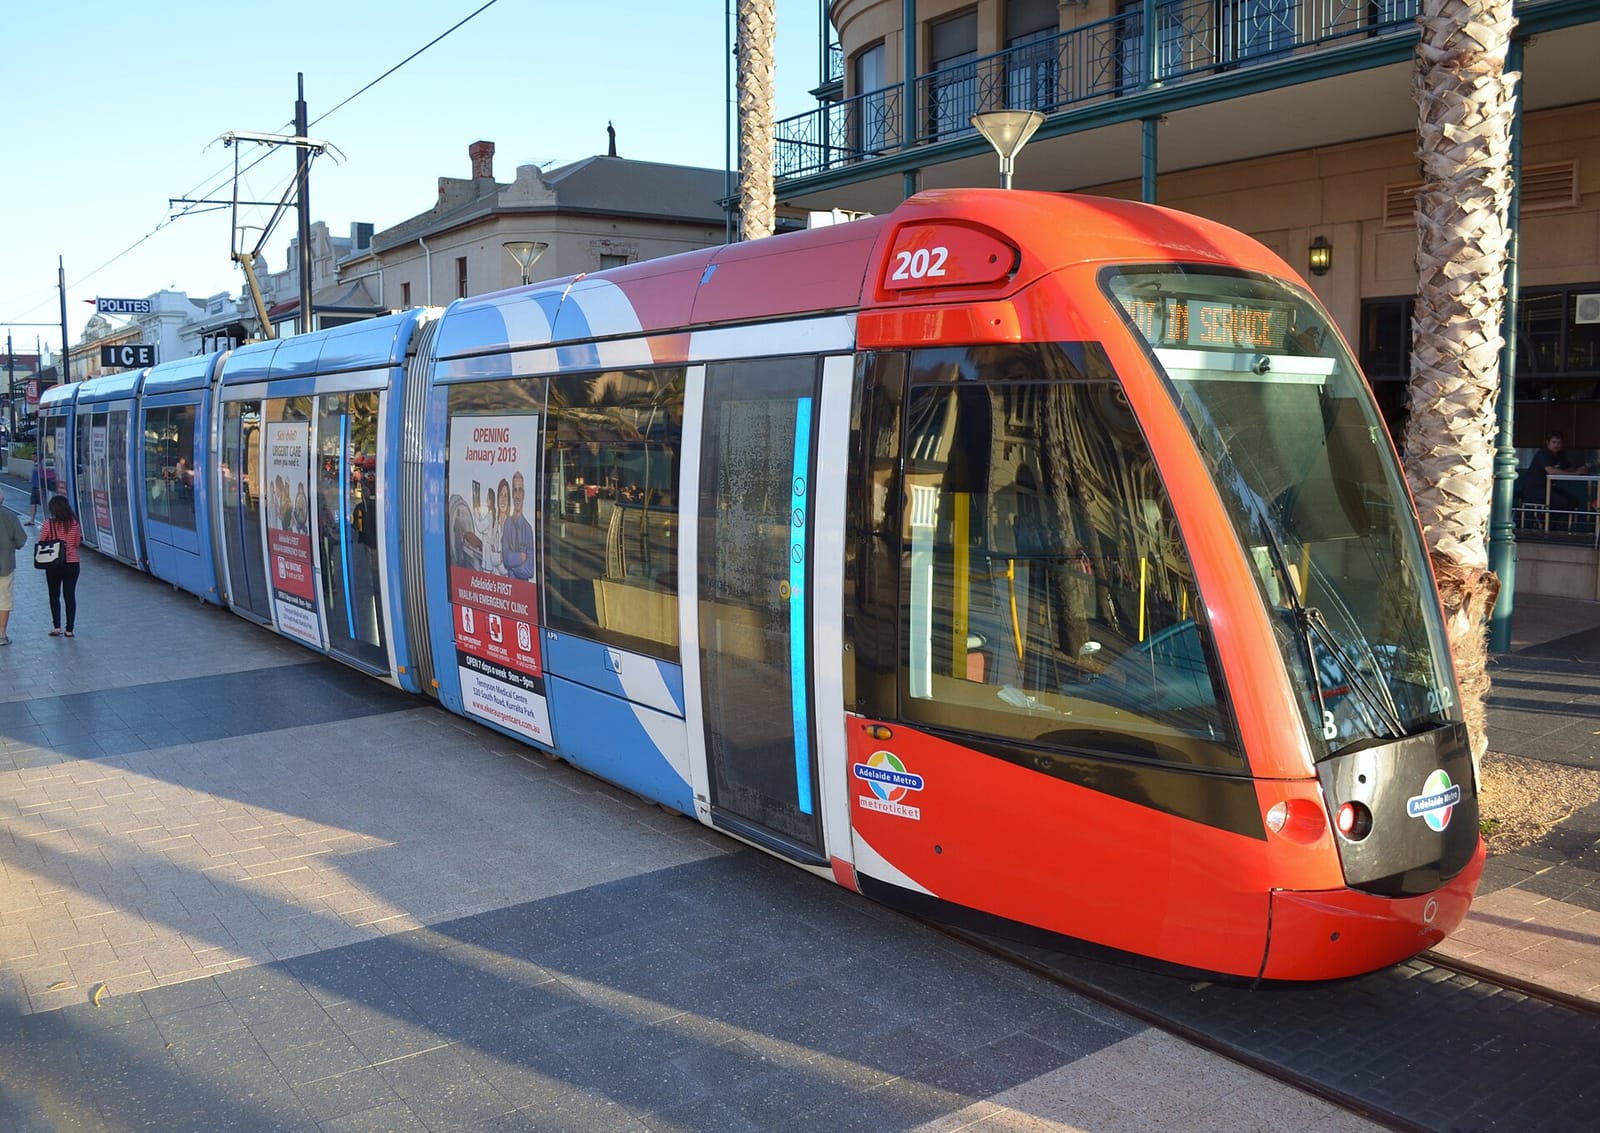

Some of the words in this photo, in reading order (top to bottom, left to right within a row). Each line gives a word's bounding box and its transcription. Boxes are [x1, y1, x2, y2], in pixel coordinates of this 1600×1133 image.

[892, 247, 948, 280] 202
[100, 300, 149, 312] POLITES
[1168, 304, 1188, 340] IN
[1200, 306, 1272, 345] SERVICE
[110, 346, 149, 365] ICE
[473, 427, 510, 443] OPENING
[272, 445, 289, 456] URGENT
[289, 445, 301, 457] CARE
[465, 446, 496, 466] January
[497, 447, 517, 463] 2013
[470, 576, 496, 592] Adelaide's
[497, 582, 512, 596] FIRST
[458, 588, 479, 603] WALK-IN
[479, 593, 510, 611] EMERGENCY
[511, 601, 529, 616] CLINIC
[466, 655, 478, 668] OPEN
[482, 661, 492, 674] days
[495, 668, 507, 678] week
[508, 671, 519, 683] 9am
[522, 676, 534, 689] 9pm
[476, 677, 495, 691] Tennyson
[495, 684, 512, 698] Medical
[513, 692, 528, 705] Centre
[1427, 687, 1453, 713] 202
[481, 690, 494, 702] South
[524, 707, 535, 719] Park
[1323, 710, 1338, 740] B
[859, 768, 891, 780] Adelaide
[893, 774, 917, 786] Metro
[860, 799, 919, 818] metroticket
[1413, 795, 1444, 811] Adelaide
[1444, 791, 1458, 802] Metro
